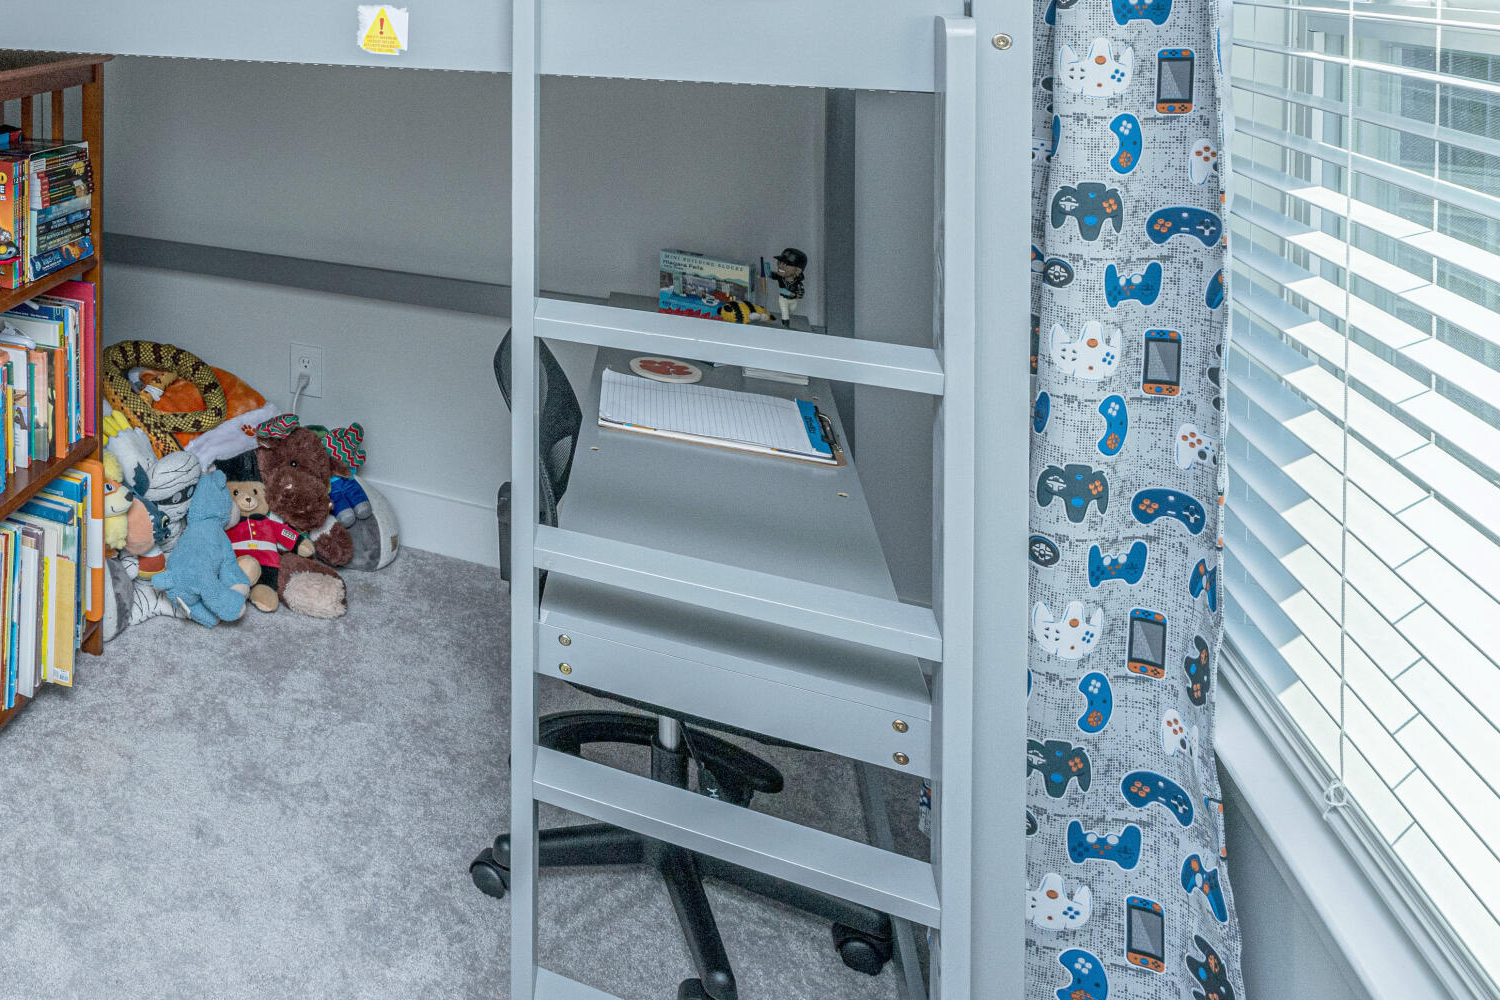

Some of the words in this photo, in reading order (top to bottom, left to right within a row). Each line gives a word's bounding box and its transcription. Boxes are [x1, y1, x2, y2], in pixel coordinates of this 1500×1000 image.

[664, 253, 682, 261] MINI
[683, 256, 715, 267] BUILDING
[717, 263, 744, 272] BLOCKS
